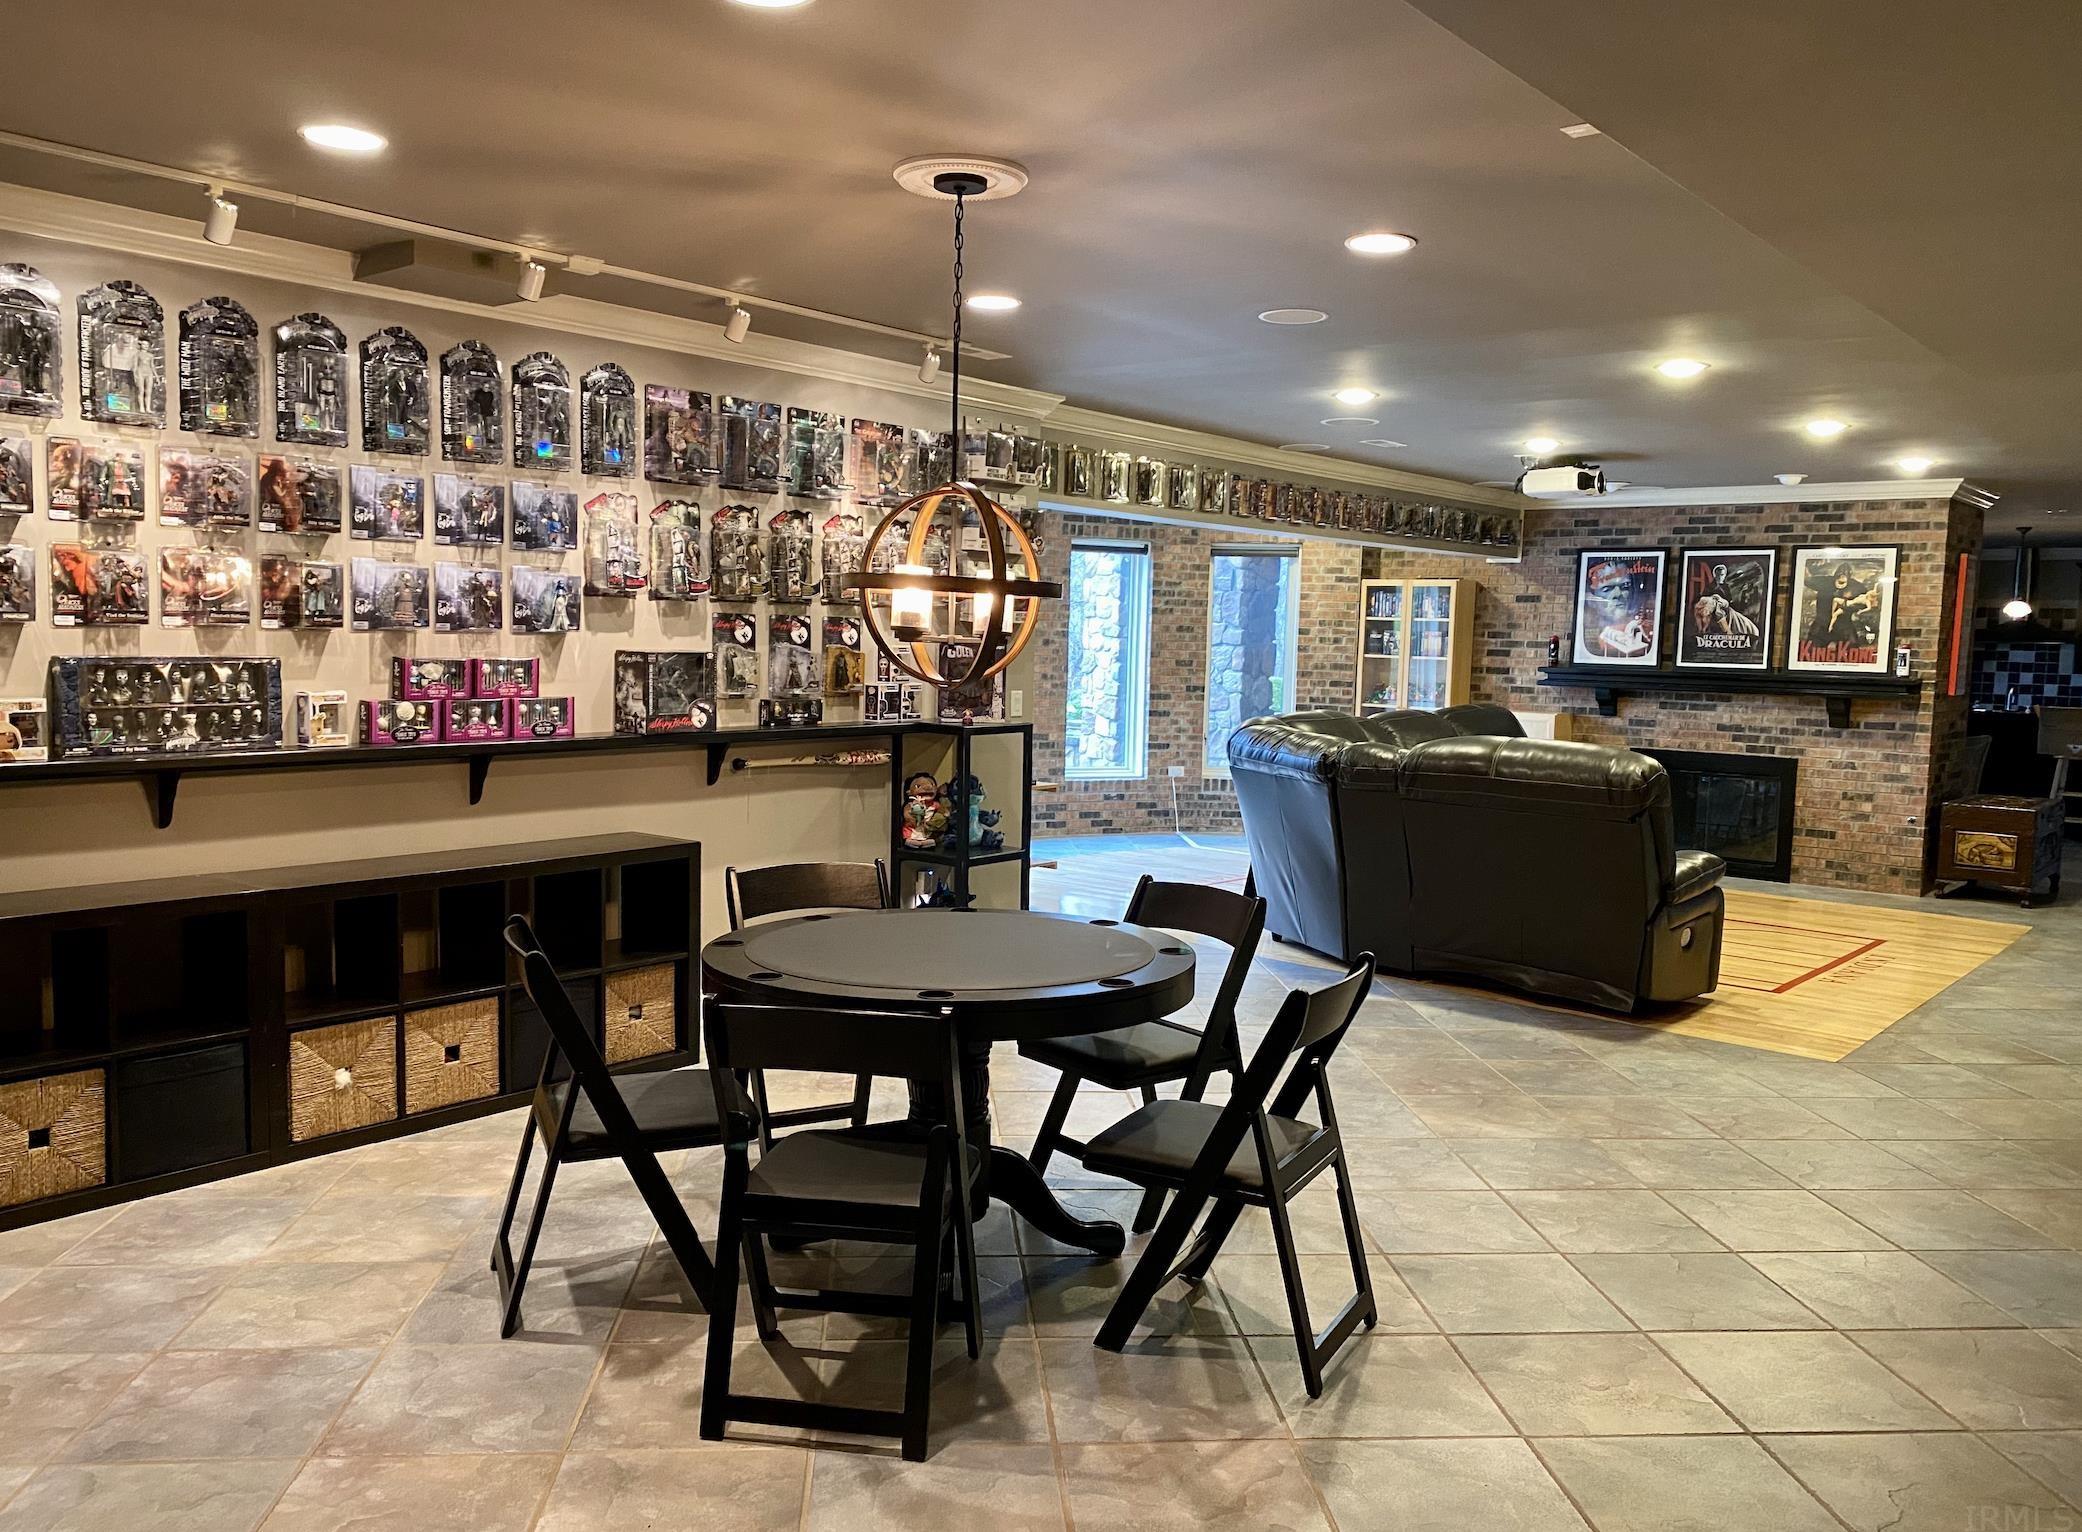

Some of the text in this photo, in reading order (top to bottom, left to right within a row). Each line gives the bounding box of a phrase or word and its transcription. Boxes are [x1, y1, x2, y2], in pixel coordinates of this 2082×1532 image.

[181, 341, 191, 390] THE WOLF MAN
[1695, 635, 1752, 649] DRACULA
[1799, 640, 1877, 663] KING KONG
